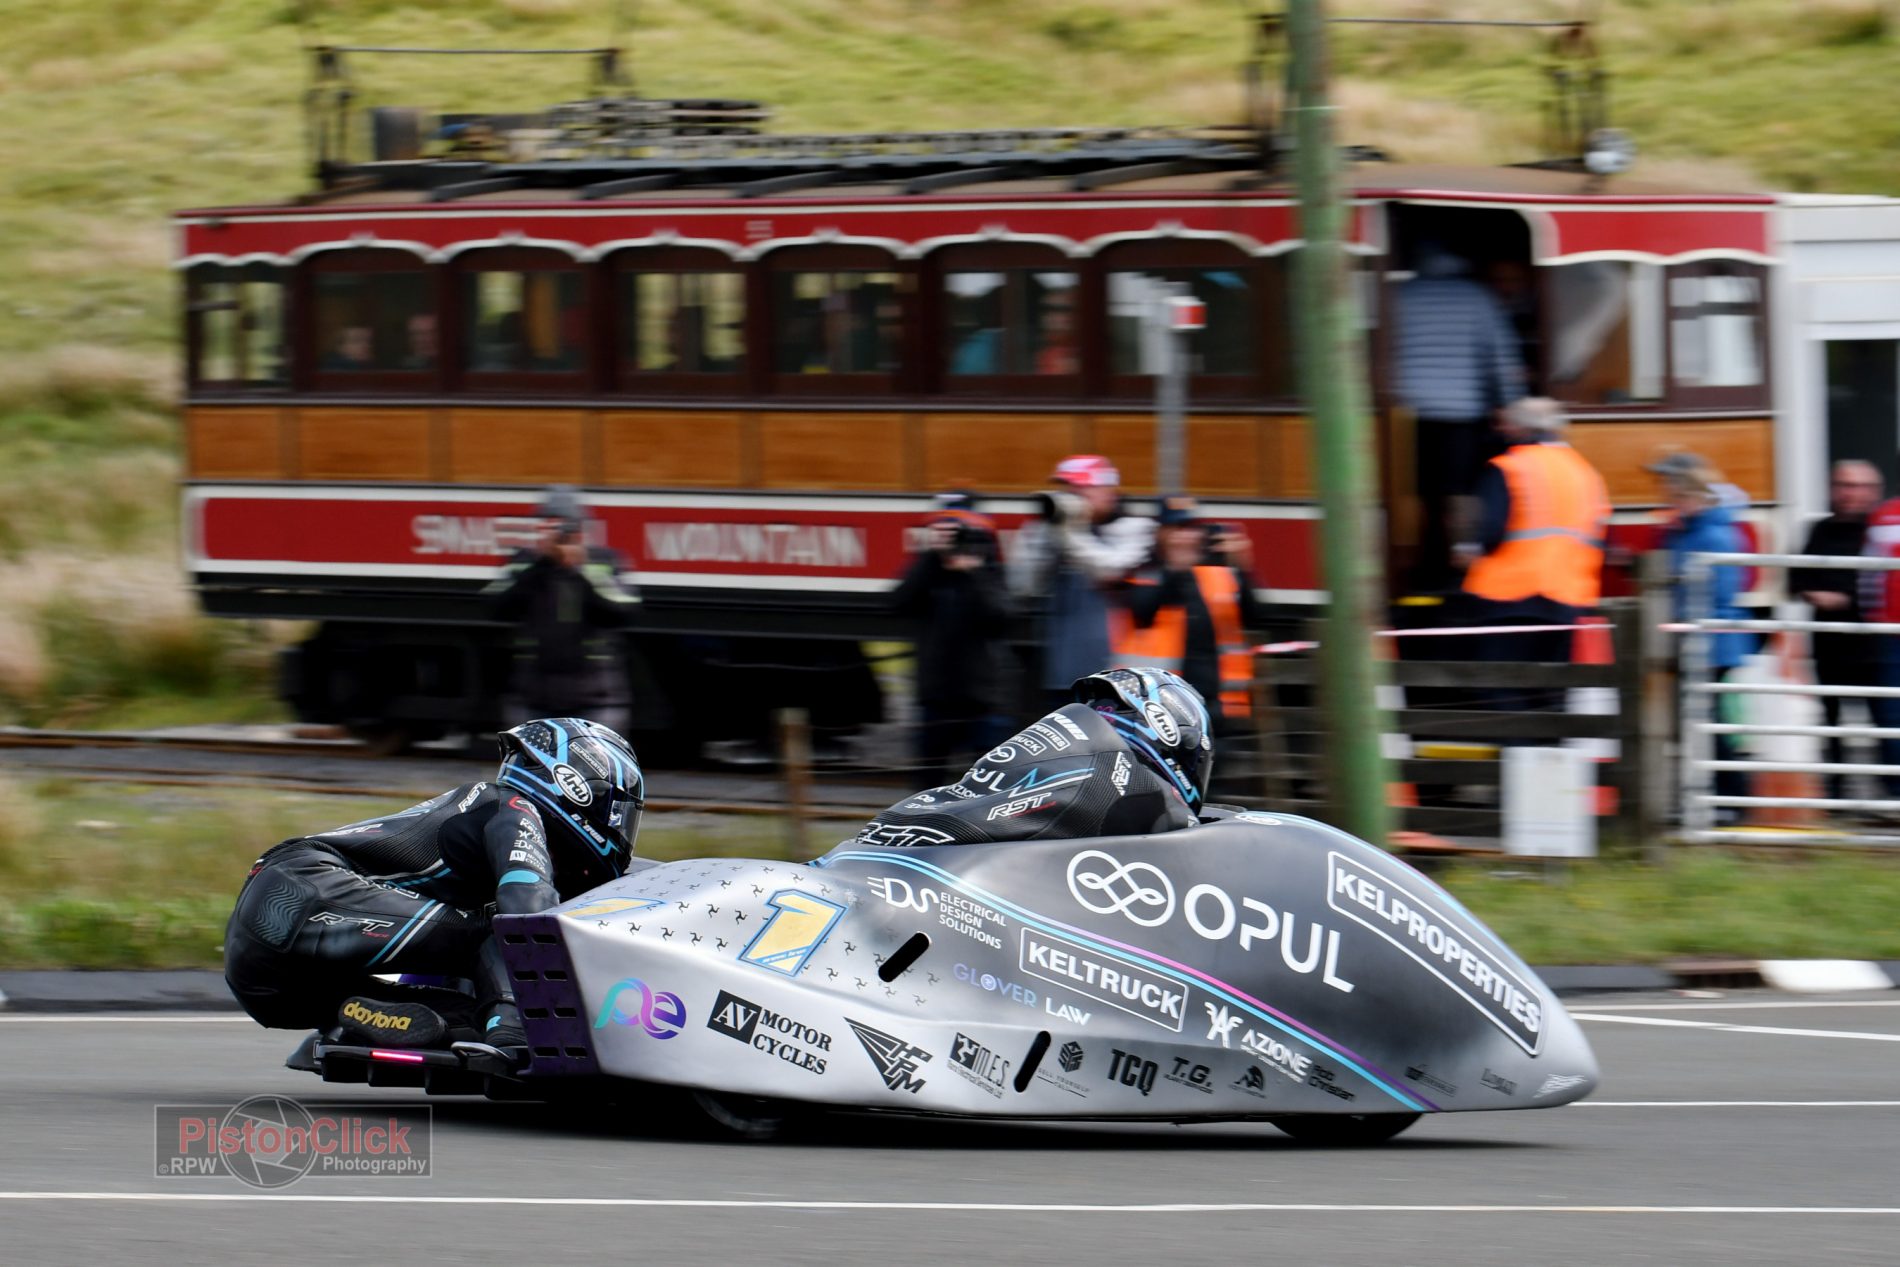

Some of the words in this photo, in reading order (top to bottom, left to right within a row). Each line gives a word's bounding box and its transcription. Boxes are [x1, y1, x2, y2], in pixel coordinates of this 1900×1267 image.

[1145, 703, 1178, 739] Arai
[554, 766, 590, 801] Arai
[939, 890, 1008, 928] ELECTRICAL
[939, 902, 984, 929] DESIGN
[738, 887, 849, 979] 1
[938, 913, 1003, 951] SOLUTIONS
[1183, 882, 1356, 994] OPUL
[1336, 866, 1542, 1034] KELPROPERTIES
[1027, 940, 1184, 1021] KELTRUCK
[343, 1001, 413, 1031] daytona
[713, 1000, 758, 1032] AV
[759, 1008, 833, 1052] MOTOR
[1044, 996, 1092, 1027] LAW
[752, 1032, 828, 1076] CYCLES
[1107, 1048, 1159, 1097] TCQ
[1240, 1028, 1313, 1078] AZIONE
